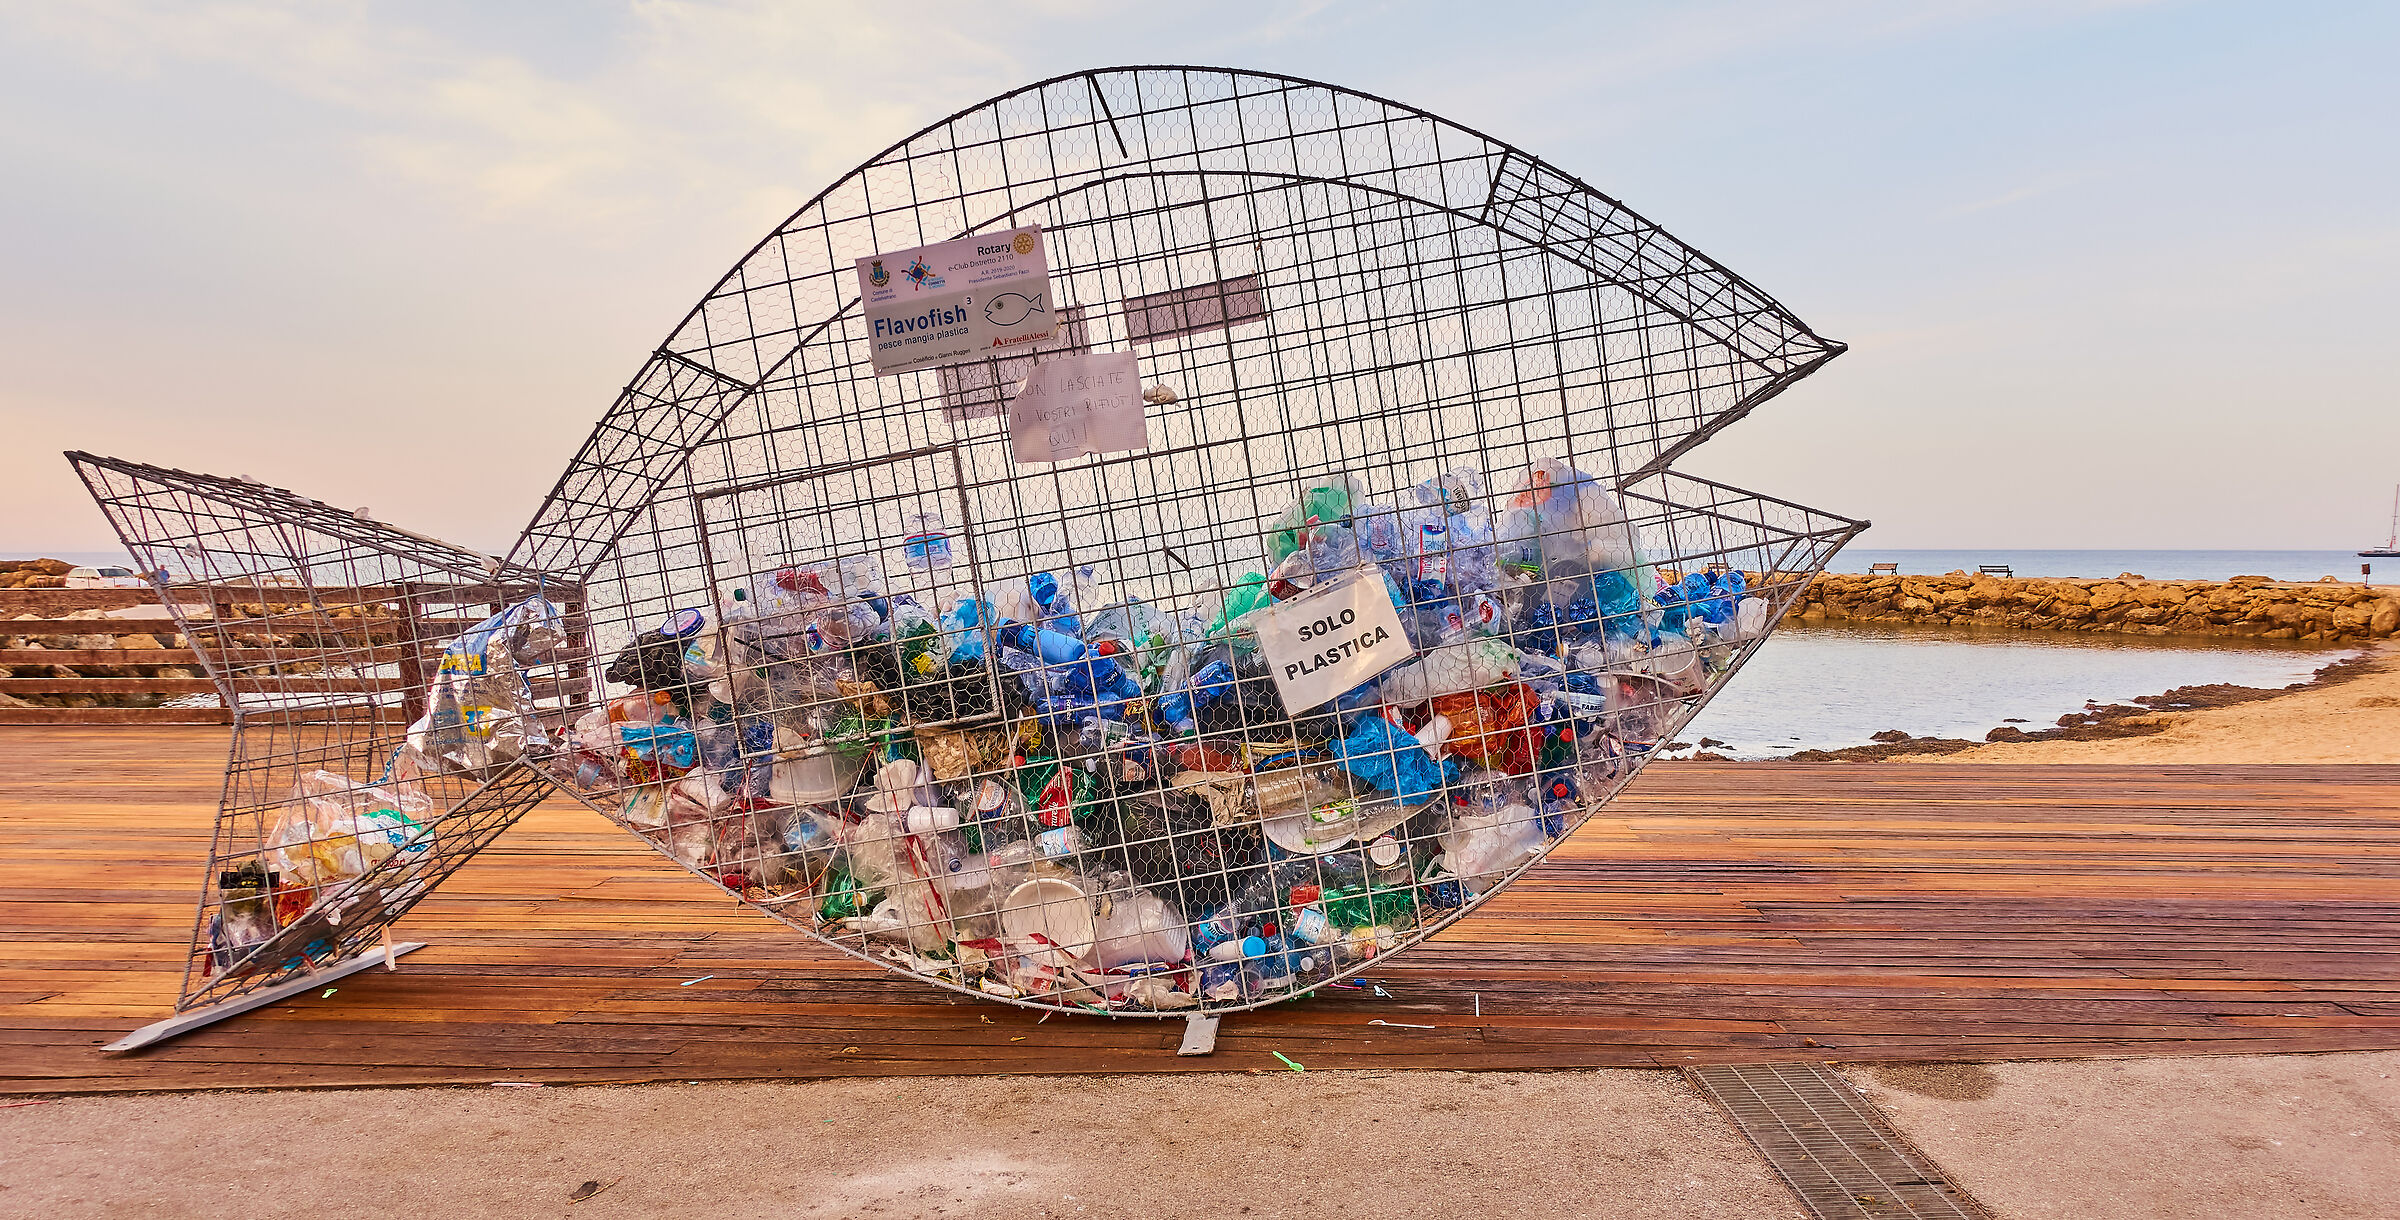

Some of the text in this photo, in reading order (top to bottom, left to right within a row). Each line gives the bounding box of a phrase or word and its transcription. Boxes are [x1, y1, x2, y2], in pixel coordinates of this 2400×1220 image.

[948, 253, 1014, 272] e-Club Distretto 2110
[977, 243, 1011, 256] Rotary
[874, 296, 972, 338] Flavofish 3
[878, 326, 969, 352] pesce mangia plastica
[1018, 370, 1125, 399] ON LASCIATE
[1035, 405, 1076, 422] VOSTRI
[1298, 608, 1356, 642] SOLO
[1284, 625, 1390, 681] PLASTICA
